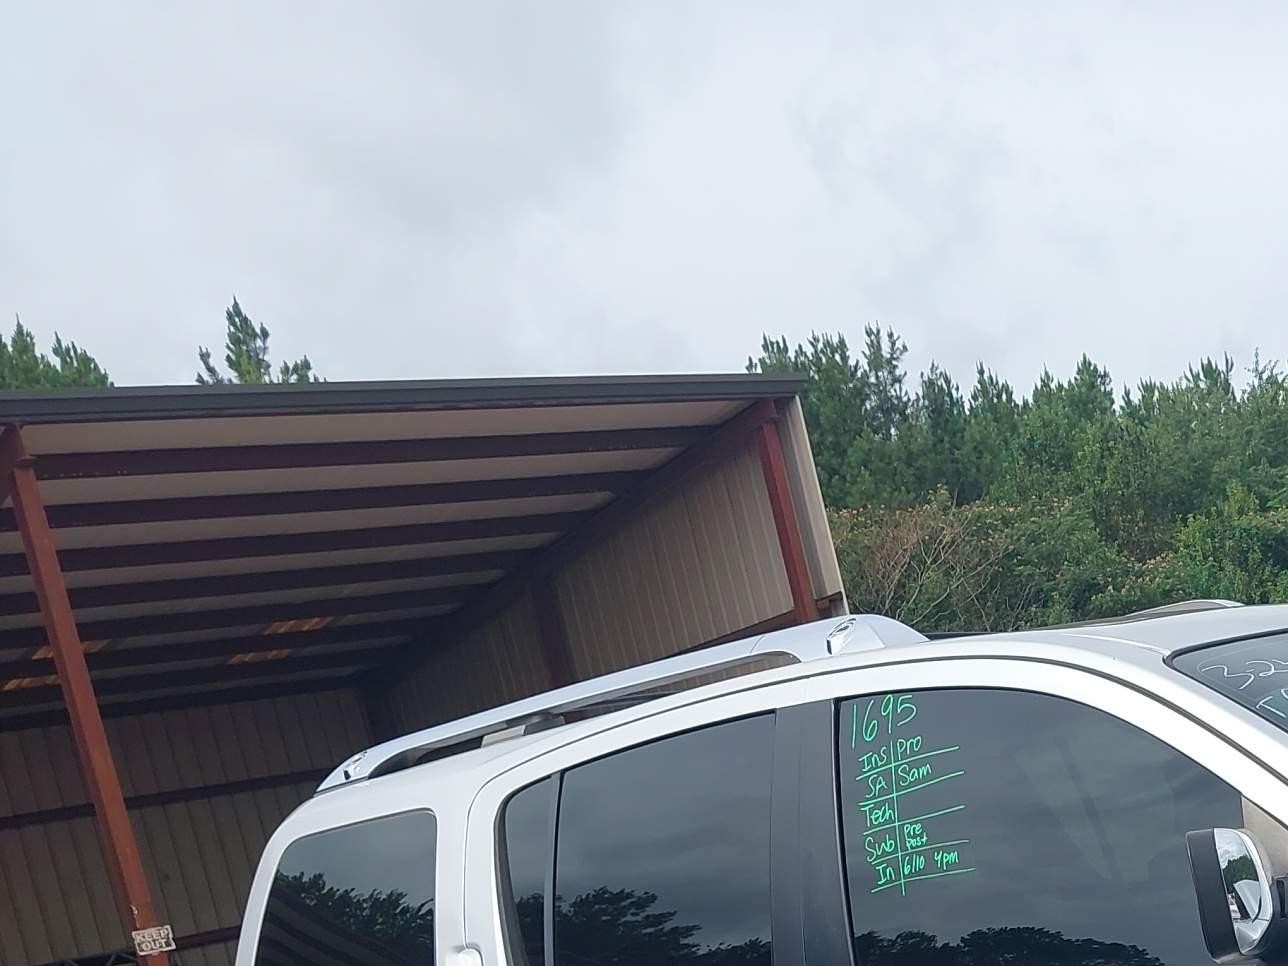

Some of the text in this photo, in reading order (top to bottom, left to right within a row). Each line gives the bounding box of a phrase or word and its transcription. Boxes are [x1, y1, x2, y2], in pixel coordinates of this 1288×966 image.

[852, 694, 917, 749] 1695
[898, 763, 932, 786] Sam
[860, 804, 895, 827] Tech
[875, 864, 896, 885] In
[136, 928, 169, 943] KEEP
[141, 939, 168, 951] OUT
